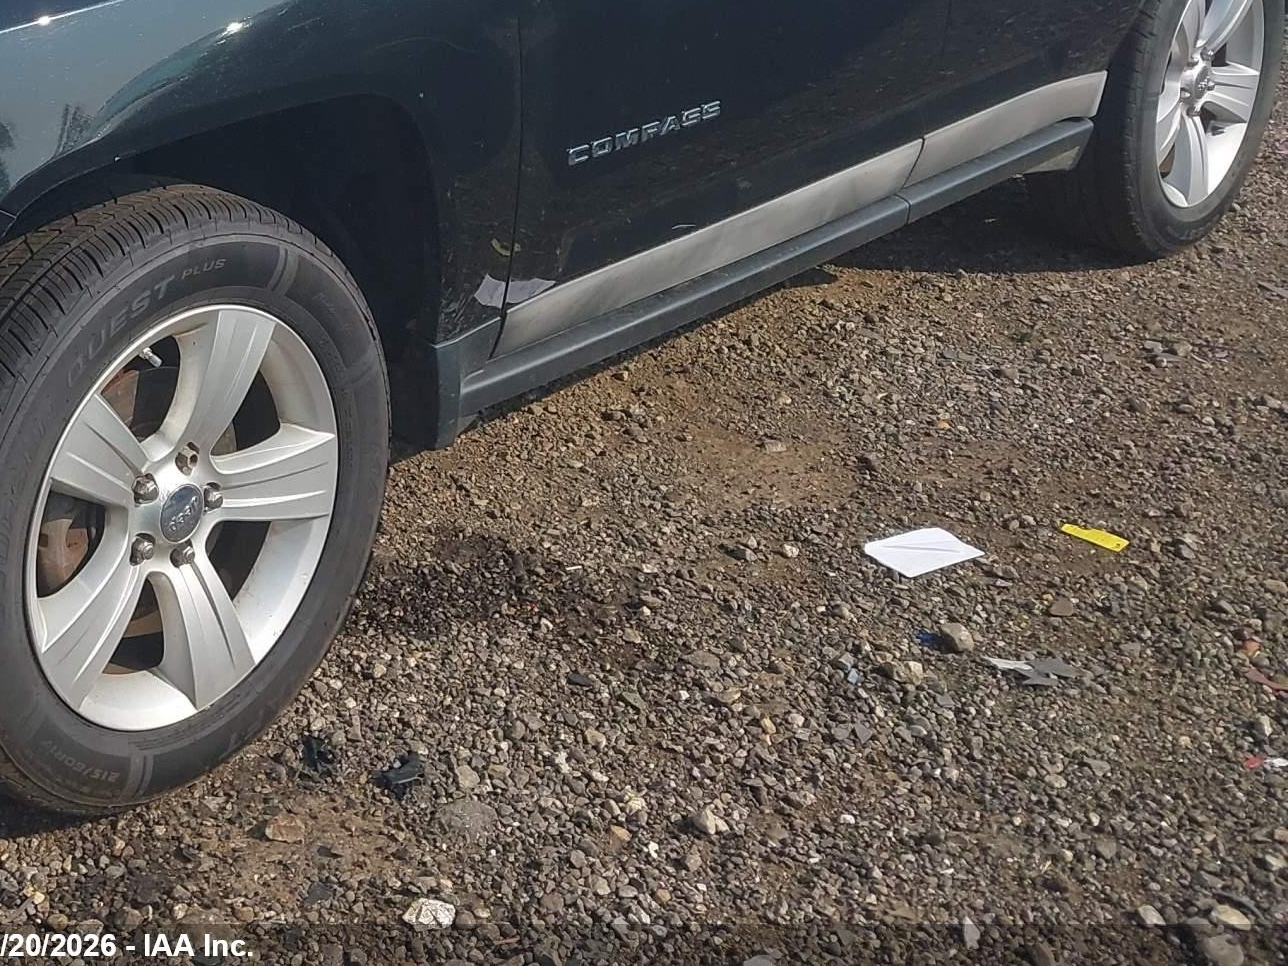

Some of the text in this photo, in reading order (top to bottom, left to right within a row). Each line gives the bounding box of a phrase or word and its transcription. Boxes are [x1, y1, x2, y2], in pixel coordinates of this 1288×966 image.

[567, 100, 721, 166] COMPASS
[66, 258, 228, 388] QUEST PLUS
